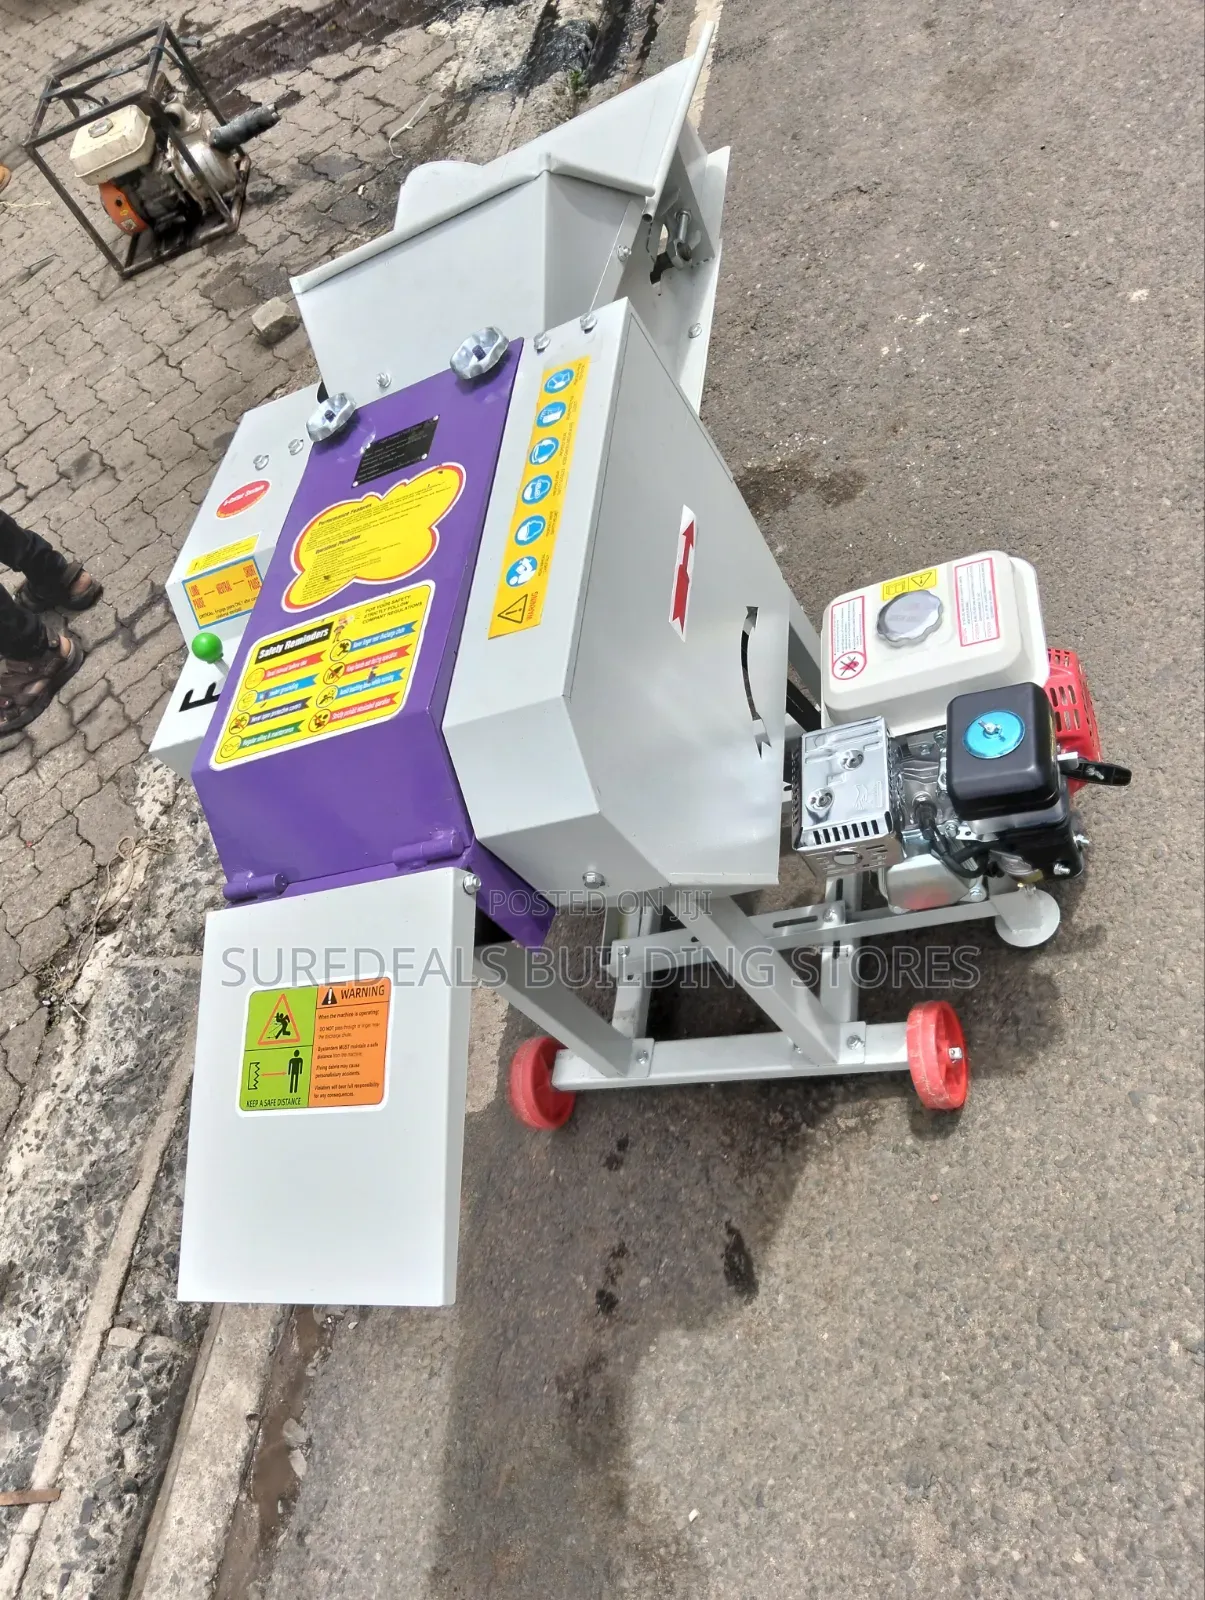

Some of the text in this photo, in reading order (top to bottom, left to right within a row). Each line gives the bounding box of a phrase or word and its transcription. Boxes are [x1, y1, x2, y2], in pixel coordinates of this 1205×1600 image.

[318, 511, 350, 526] Performance
[390, 595, 411, 606] SAFETY
[362, 601, 422, 624] COMPANY REGULATIONS
[364, 601, 409, 618] STRICTLY FOLLOW
[258, 627, 328, 660] Safety Reminders
[340, 984, 384, 1000] WARNING
[354, 1080, 379, 1089] responsibility
[246, 1100, 258, 1108] KEEP
[263, 1098, 276, 1106] SAFE
[277, 1097, 302, 1106] DISTANCE
